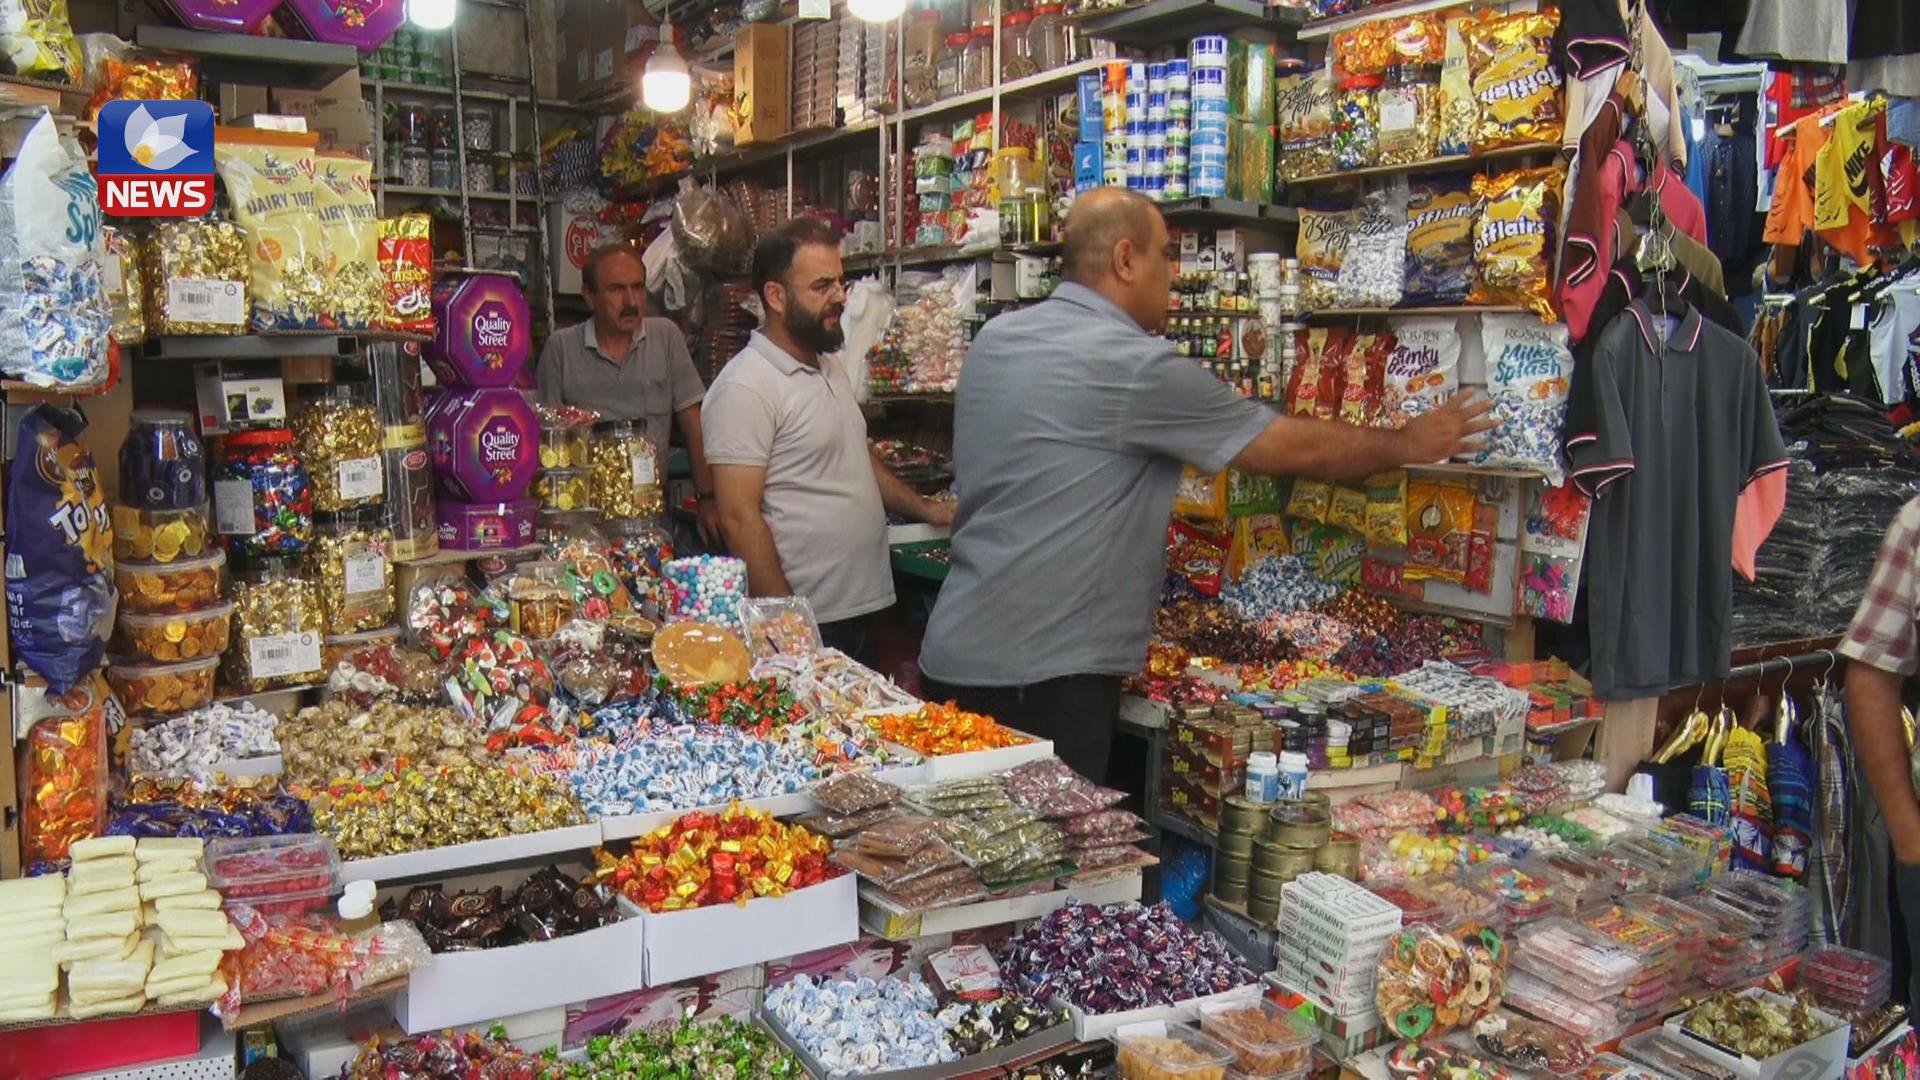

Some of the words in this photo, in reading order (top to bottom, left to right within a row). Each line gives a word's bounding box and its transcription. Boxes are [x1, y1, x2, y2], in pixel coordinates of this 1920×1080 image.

[1844, 140, 1870, 184] NIKE
[246, 192, 289, 215] DAIRY
[474, 315, 512, 336] Quality
[478, 329, 508, 346] Street
[1494, 358, 1561, 386] Splash
[482, 431, 520, 450] Quality
[485, 448, 516, 461] Street
[1299, 899, 1345, 931] SPEARMINT
[1300, 916, 1345, 948] SPEARMINT
[1297, 931, 1344, 960] SPEARMINT
